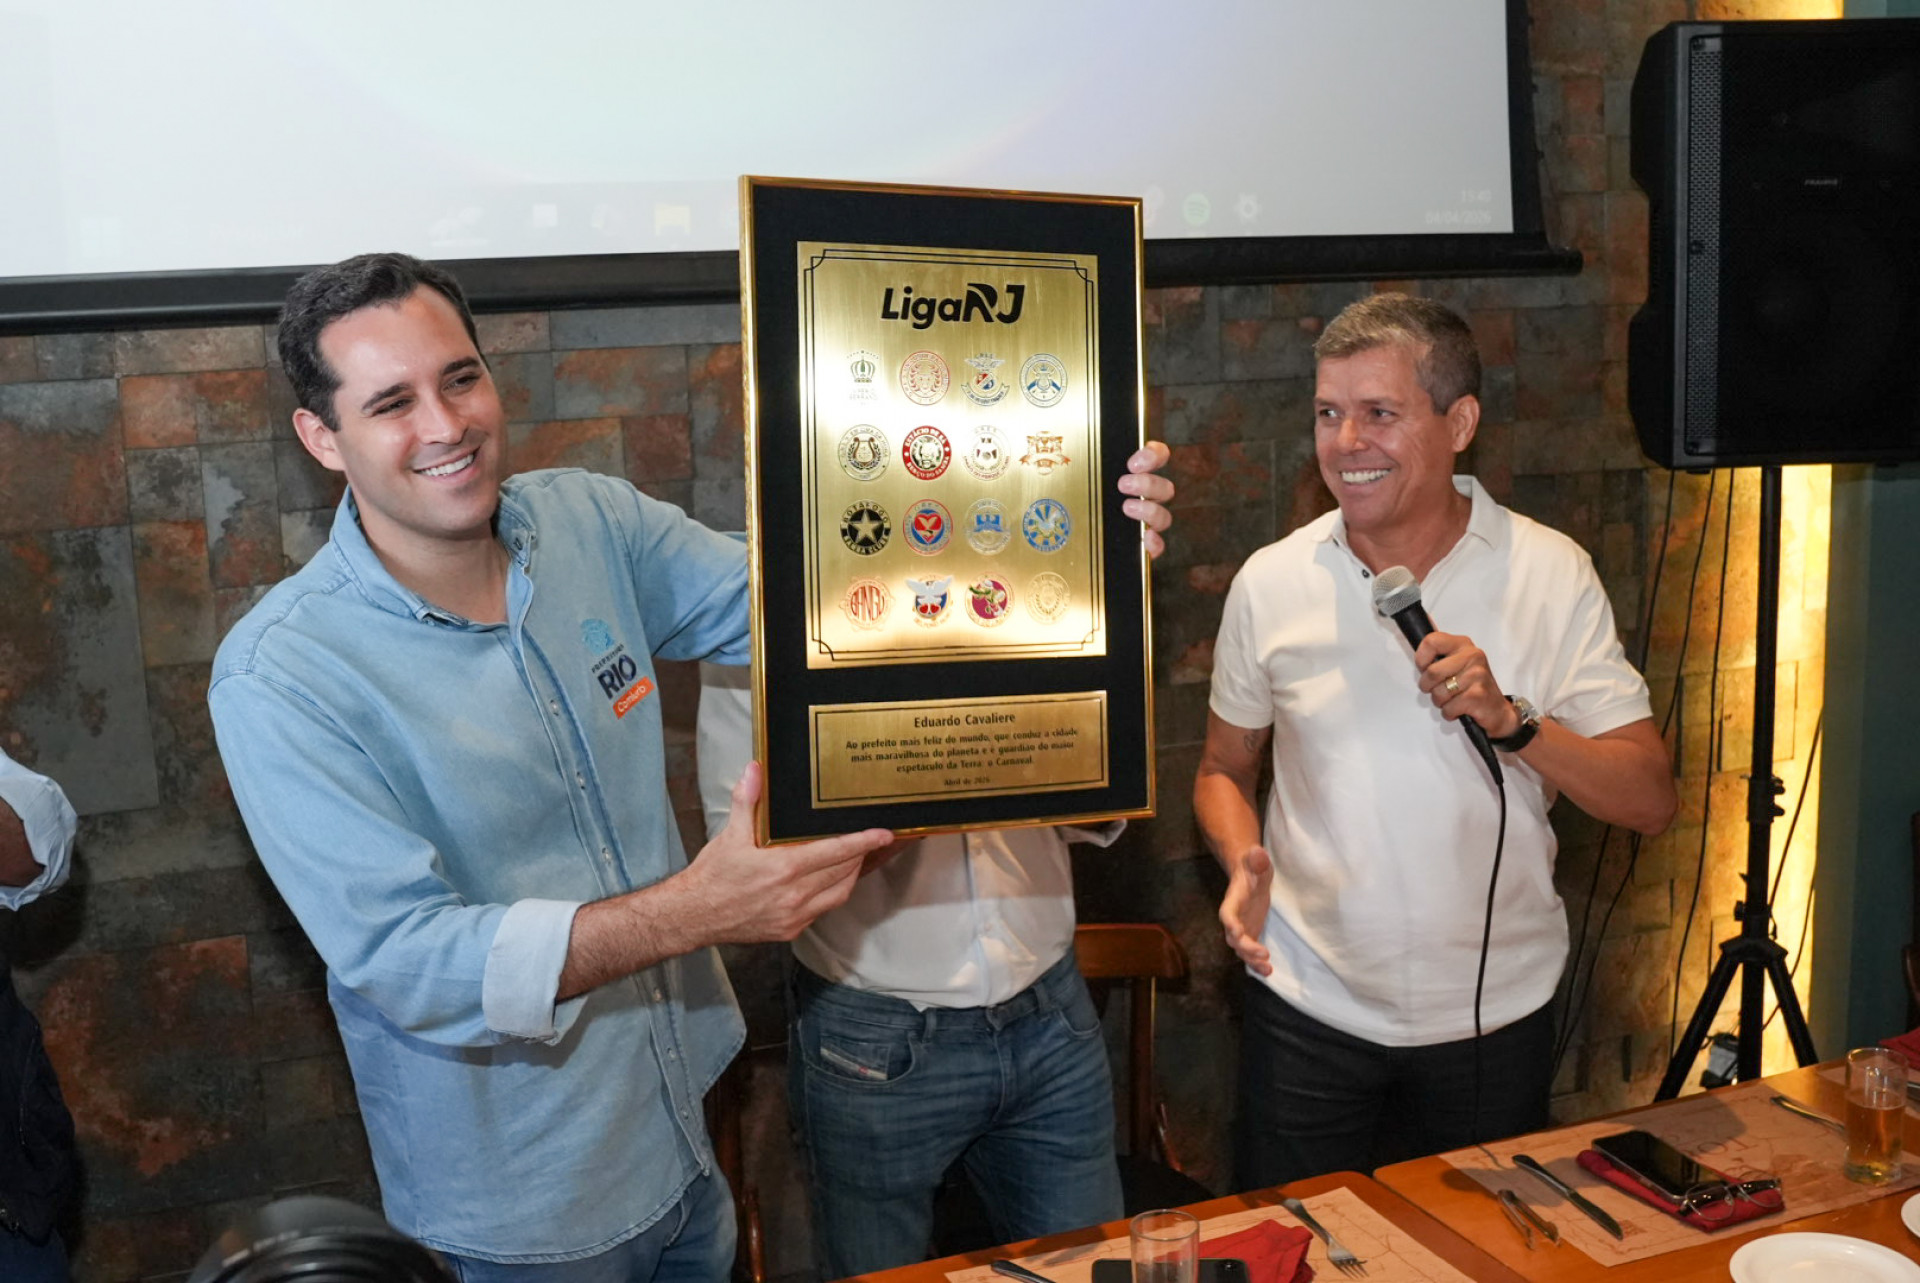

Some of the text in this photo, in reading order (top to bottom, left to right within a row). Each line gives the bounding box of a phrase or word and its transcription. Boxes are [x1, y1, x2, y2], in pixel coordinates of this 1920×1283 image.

[843, 501, 889, 524] BOTAFOGO
[597, 654, 637, 700] RIO
[914, 713, 1016, 728] Eduardo Cavaliere
[846, 741, 858, 749] Ao
[861, 738, 897, 750] prefeito
[900, 737, 920, 746] mais
[924, 736, 942, 745] feliz
[945, 735, 956, 744] do
[994, 733, 1009, 742] que
[1013, 729, 1041, 740] conduz
[1052, 727, 1078, 737] cidade
[851, 753, 873, 762] mais
[876, 750, 930, 761] maravilhosa
[933, 748, 944, 758] do
[947, 747, 979, 757] planeta
[1038, 742, 1049, 751] do
[1051, 741, 1074, 750] maior
[947, 761, 957, 770] da
